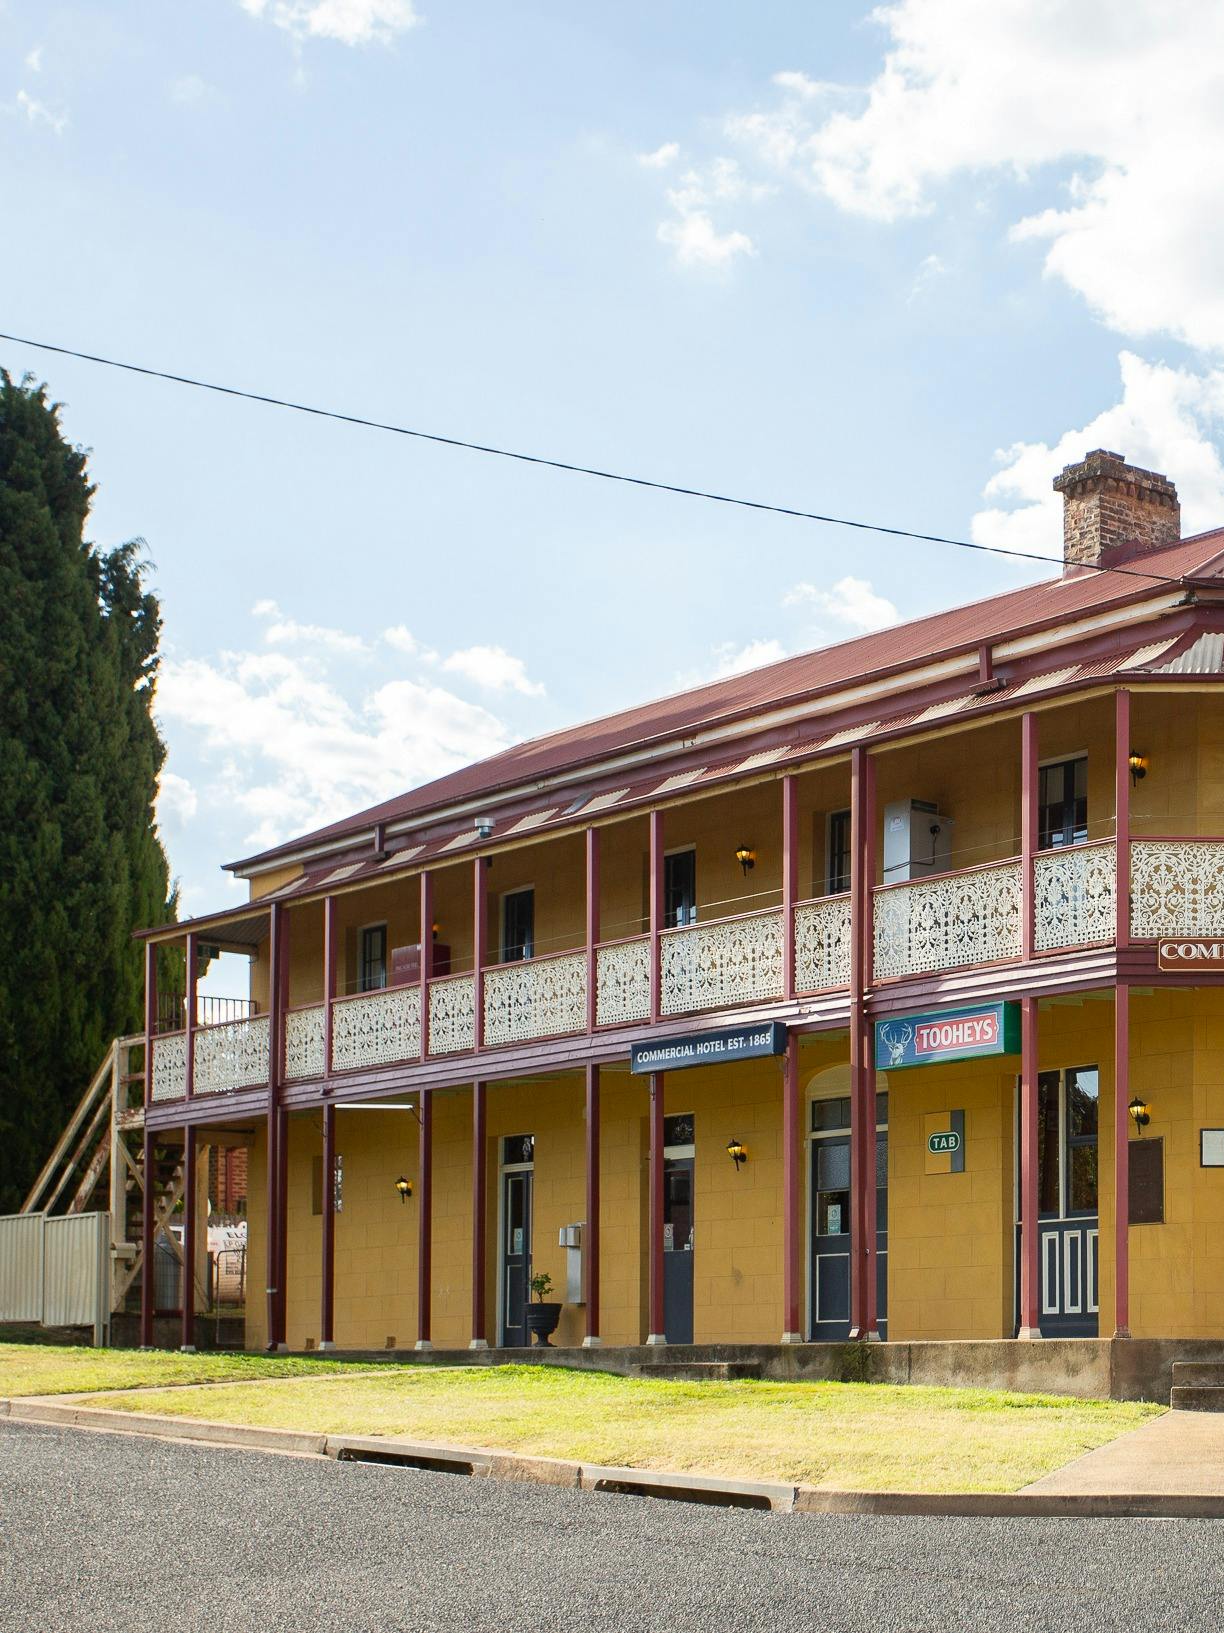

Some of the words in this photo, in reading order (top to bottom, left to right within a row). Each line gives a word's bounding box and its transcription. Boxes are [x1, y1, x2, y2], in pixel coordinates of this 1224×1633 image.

[637, 1045, 694, 1063] COMMERCIAL
[697, 1040, 725, 1055] HOTEL
[728, 1036, 746, 1049] EST.
[749, 1032, 771, 1047] 1865
[920, 1019, 993, 1049] TOOHEYS
[933, 1136, 956, 1149] TAB
